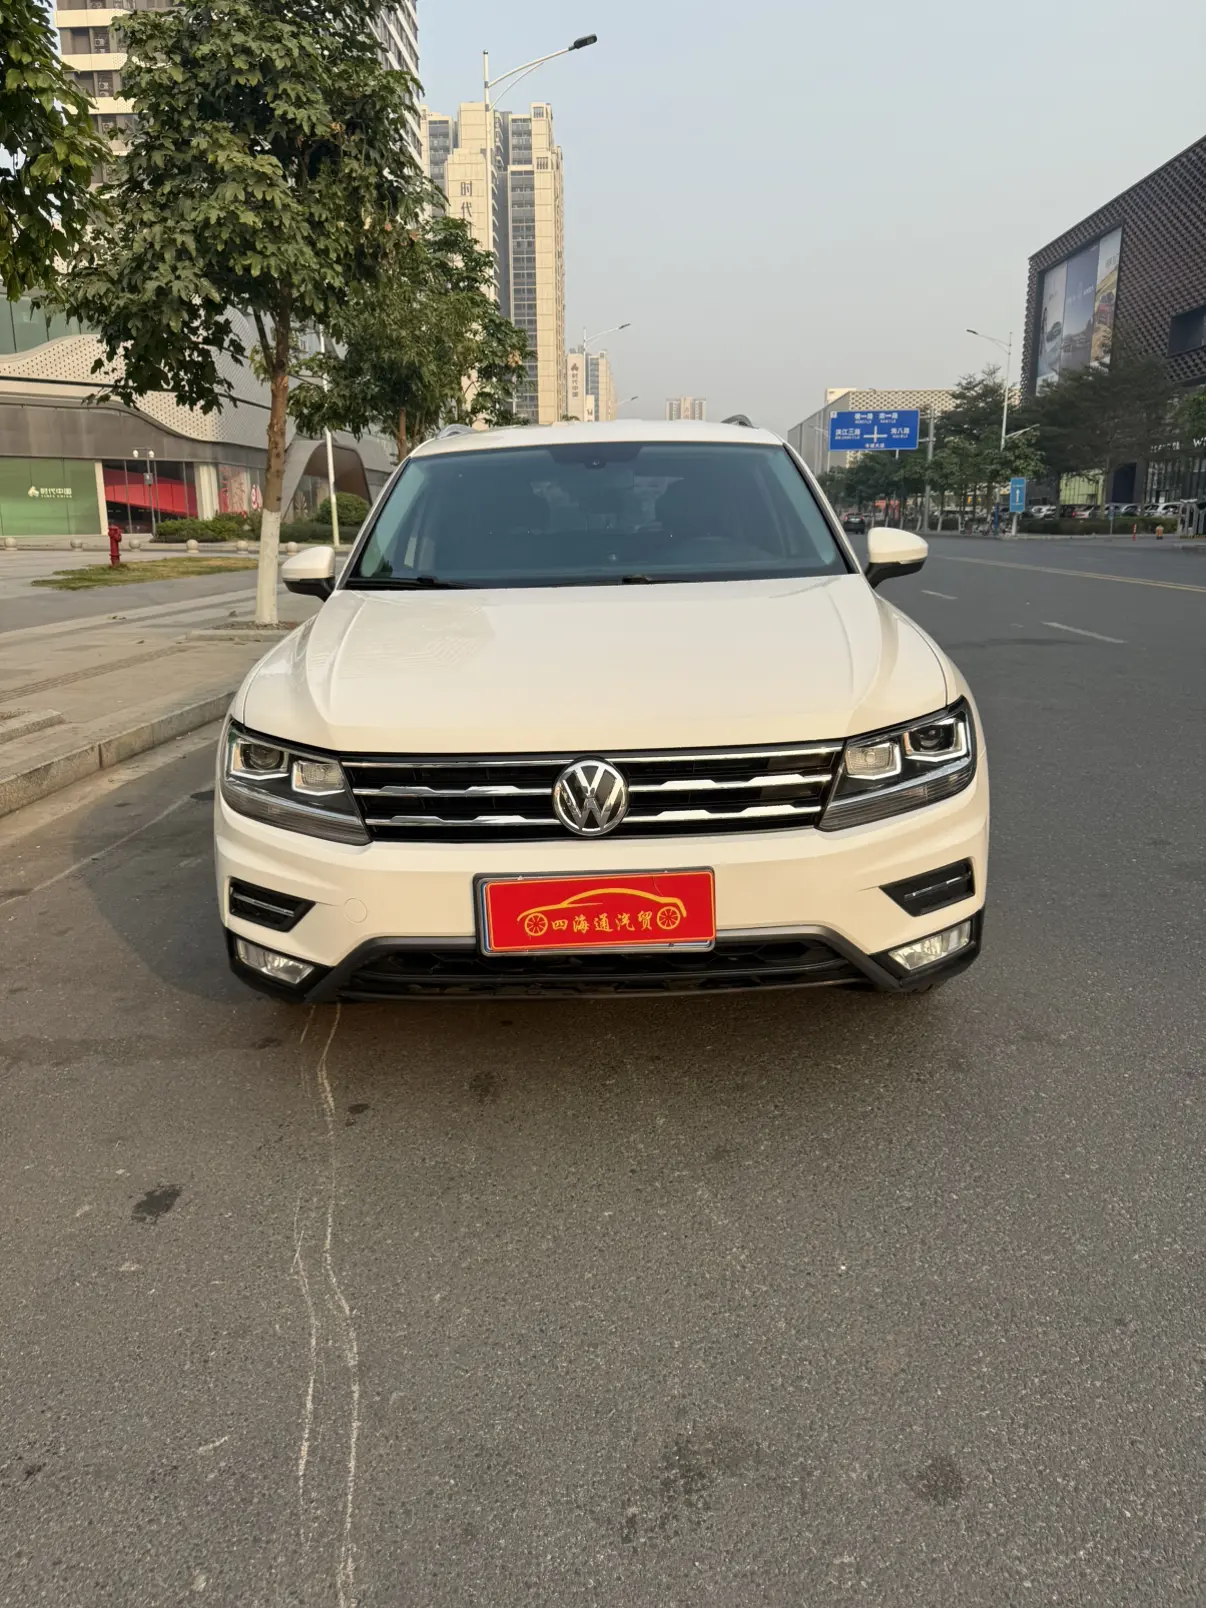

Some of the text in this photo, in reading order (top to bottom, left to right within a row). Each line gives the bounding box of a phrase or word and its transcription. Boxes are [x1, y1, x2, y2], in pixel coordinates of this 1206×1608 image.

[551, 910, 653, 934] 四海通汽贸
